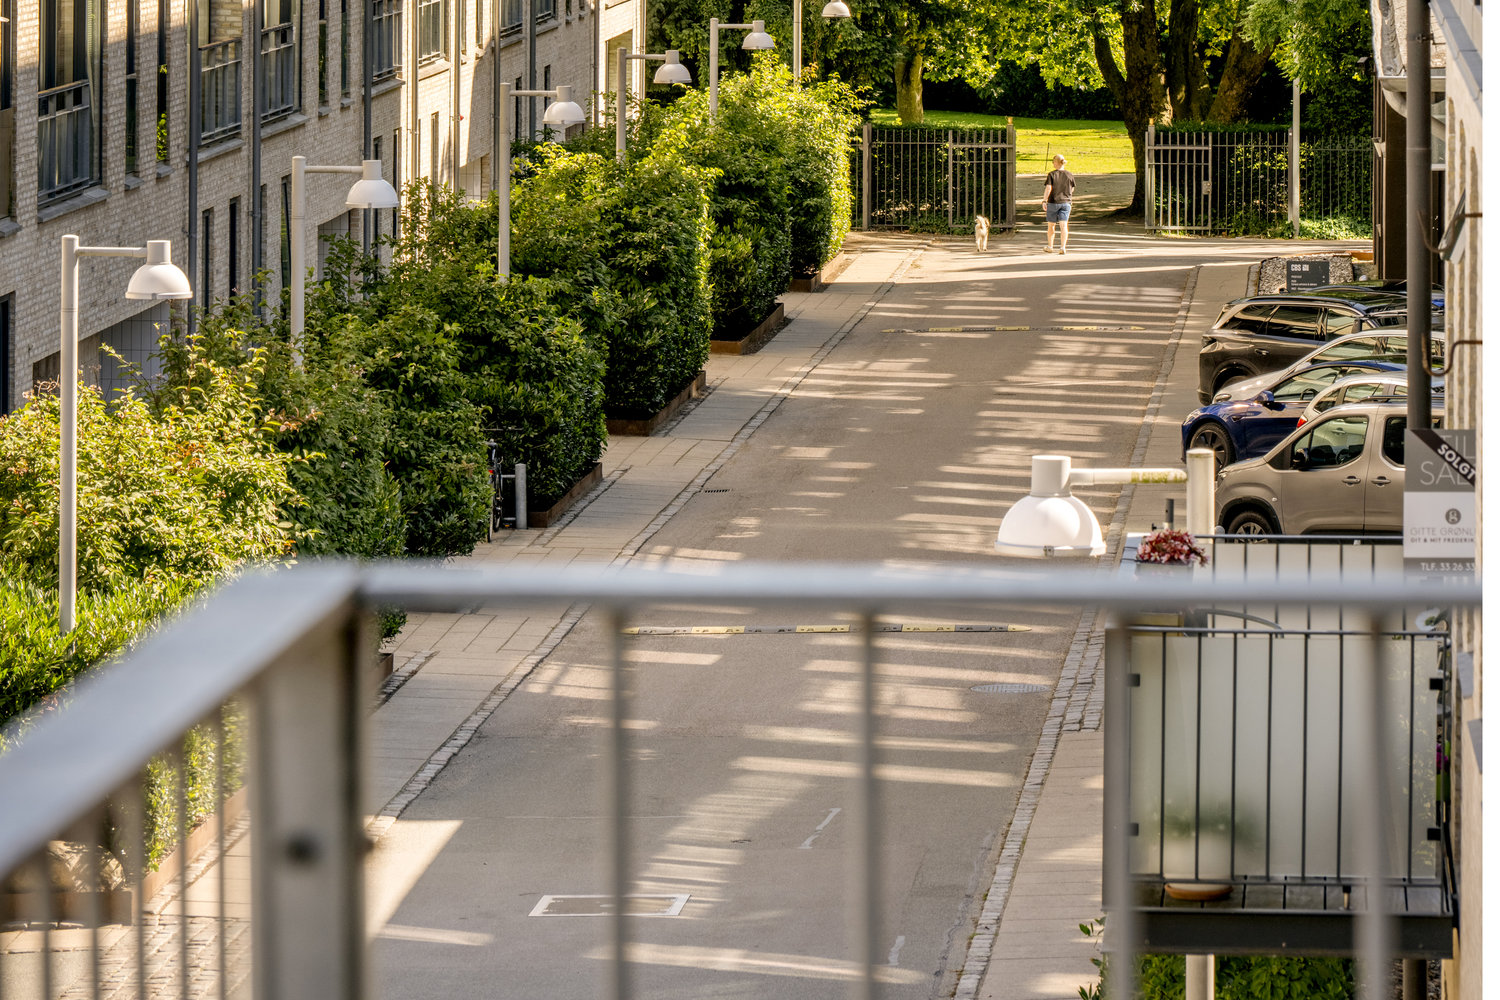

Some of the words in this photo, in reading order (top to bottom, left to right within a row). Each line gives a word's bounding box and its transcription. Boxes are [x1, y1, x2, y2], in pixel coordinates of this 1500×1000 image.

[1437, 444, 1476, 479] SOLGT
[1420, 461, 1473, 485] SAL
[1411, 527, 1436, 536] GITTE
[1440, 527, 1475, 536] GRØNL
[1421, 562, 1437, 571] TLF.
